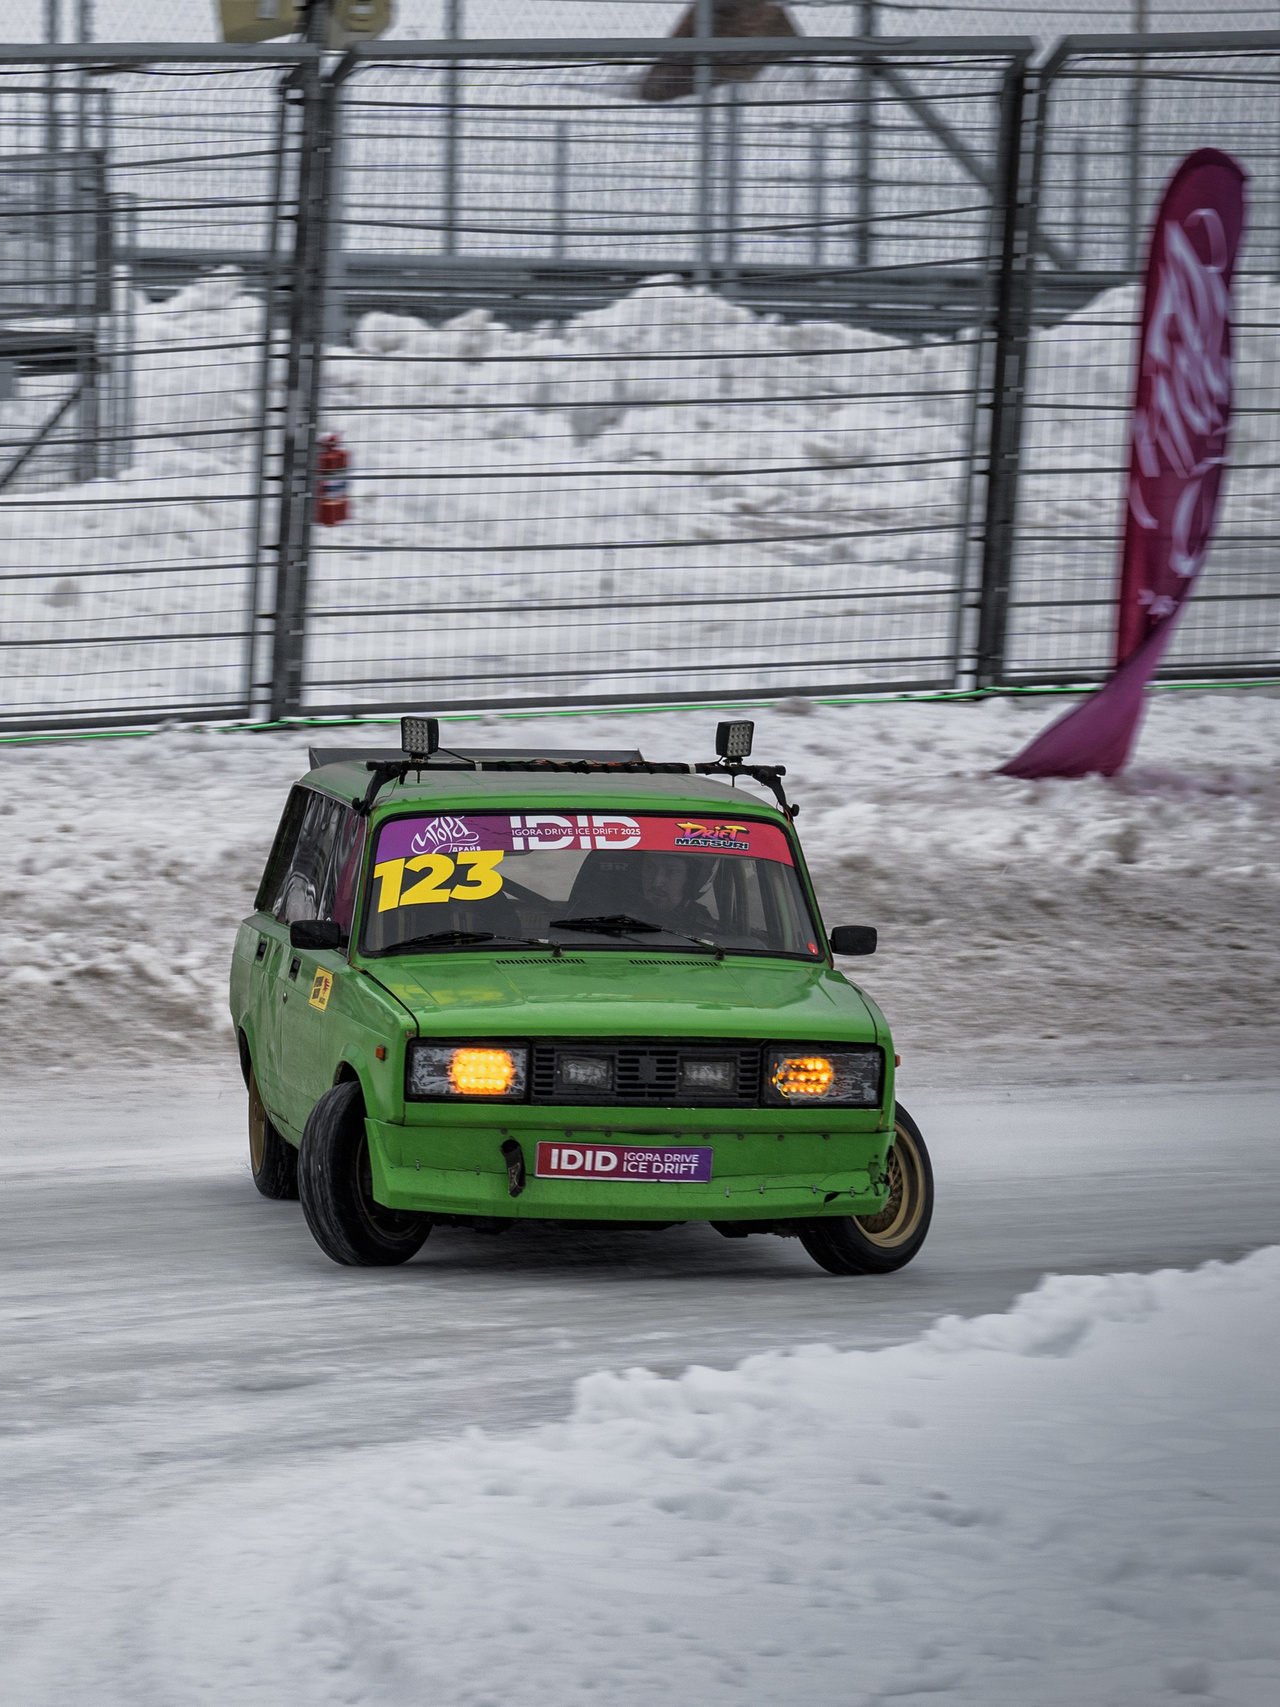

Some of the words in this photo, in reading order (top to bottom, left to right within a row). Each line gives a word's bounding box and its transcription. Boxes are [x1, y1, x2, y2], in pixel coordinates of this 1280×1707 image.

[510, 815, 641, 850] IDID
[512, 828, 543, 836] IGORA
[675, 838, 749, 850] MATSURI
[373, 850, 504, 913] 123
[550, 1149, 618, 1171] IDID
[624, 1152, 661, 1162] IGORA
[663, 1153, 699, 1163] DRIVE
[623, 1161, 648, 1173] ICE
[652, 1162, 699, 1174] DRIFT
